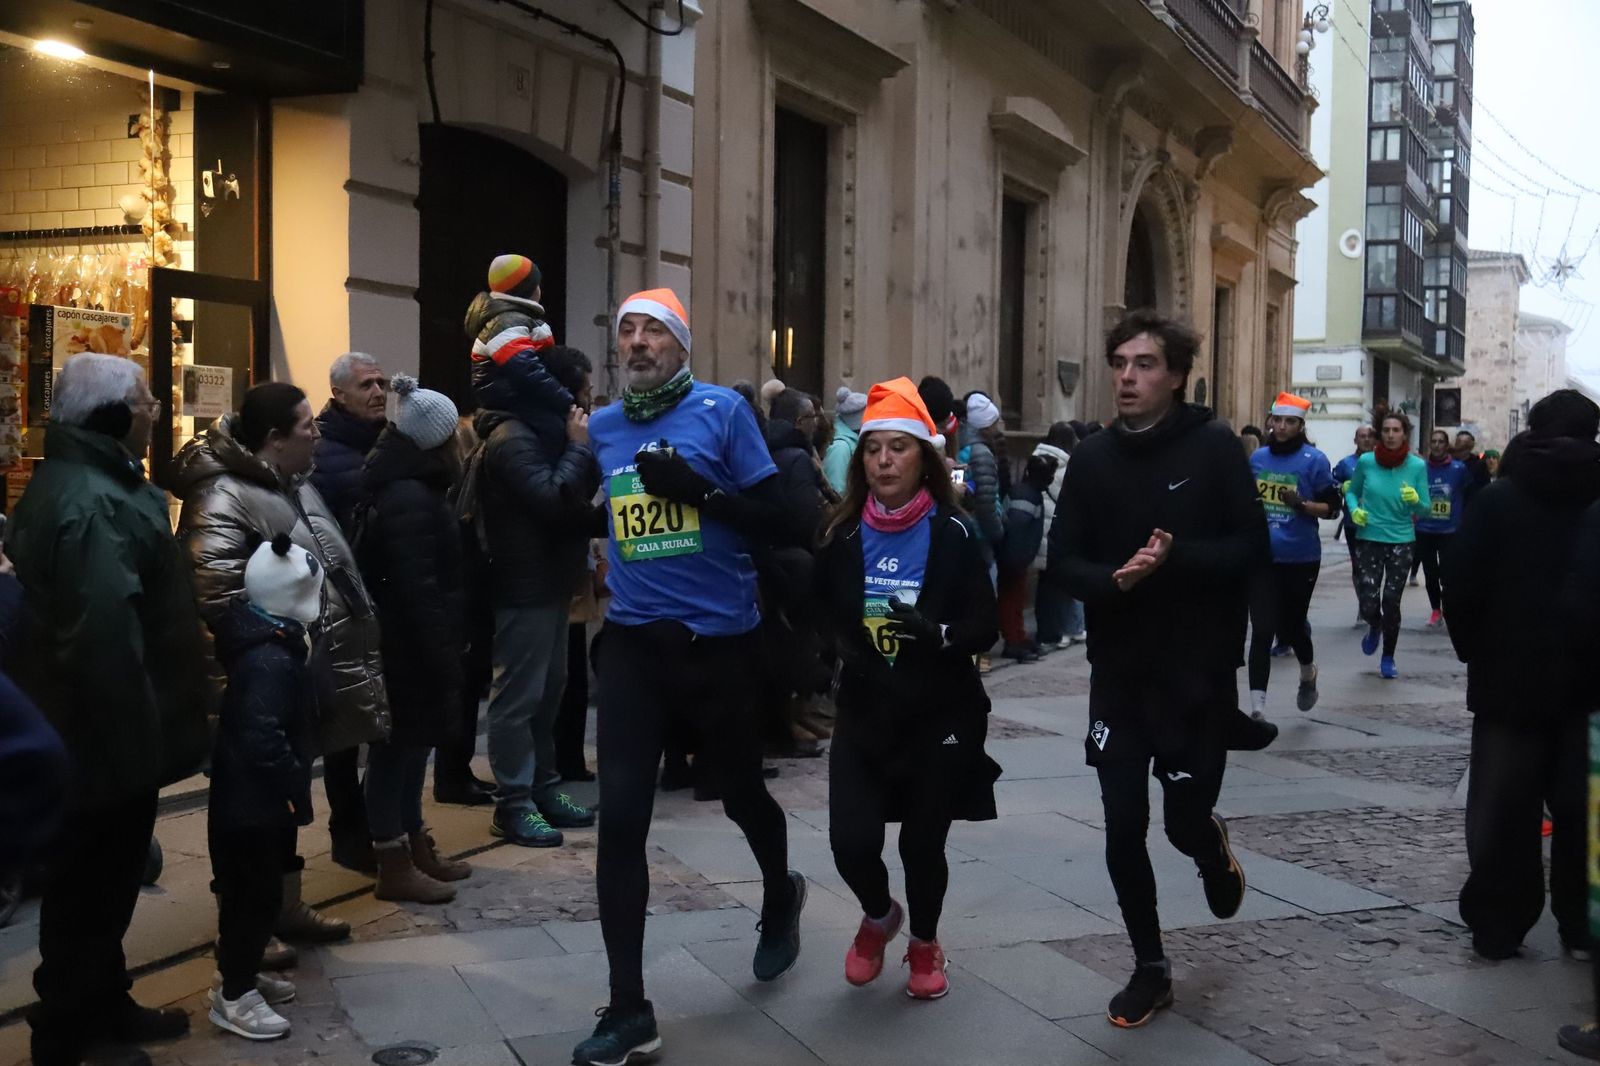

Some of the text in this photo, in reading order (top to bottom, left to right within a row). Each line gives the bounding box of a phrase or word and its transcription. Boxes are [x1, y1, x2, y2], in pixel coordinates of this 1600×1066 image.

[57, 310, 119, 325] capón cascajares
[45, 309, 53, 349] cascajares
[199, 374, 224, 386] 03322
[43, 371, 52, 411] cascajares
[618, 500, 684, 539] 1320
[636, 538, 697, 553] CAJA RURAL
[876, 556, 899, 573] 46
